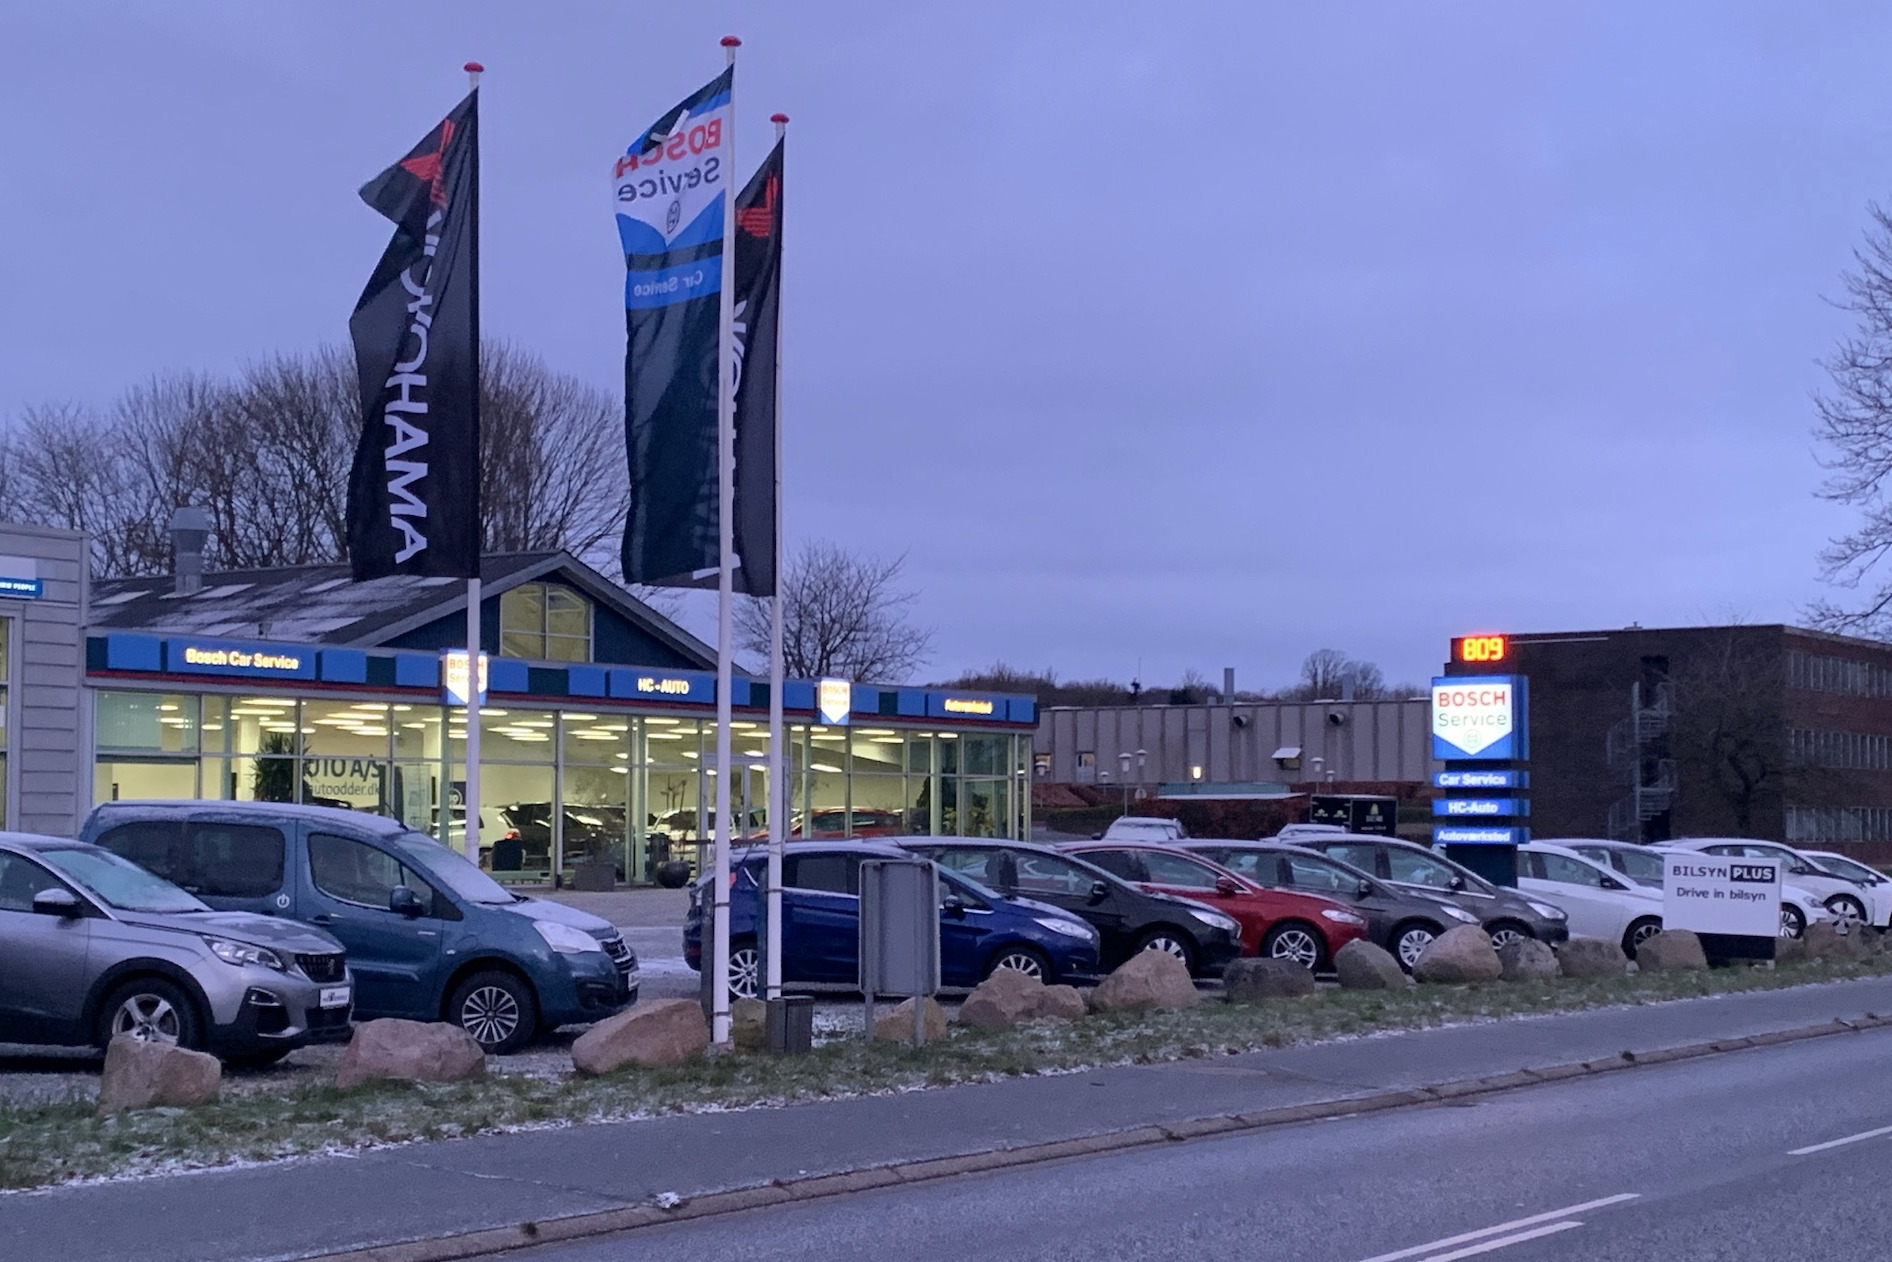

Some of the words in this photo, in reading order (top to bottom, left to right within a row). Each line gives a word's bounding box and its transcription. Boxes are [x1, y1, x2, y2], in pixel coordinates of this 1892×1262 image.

[1463, 637, 1505, 661] 809
[185, 648, 227, 665] Bosch
[229, 651, 252, 667] Car
[254, 653, 299, 670] Service
[450, 659, 484, 670] BOSH
[1438, 691, 1506, 708] BOSCH
[1438, 712, 1507, 727] Service
[1439, 773, 1460, 785] Car
[1462, 773, 1507, 786] Service
[1448, 801, 1499, 814] HC-Auto
[1672, 865, 1728, 878] BILSYN
[1732, 866, 1773, 880] PLUS
[1676, 887, 1709, 899] Drive
[1713, 888, 1725, 899] in
[1729, 890, 1767, 903] bilsyn
